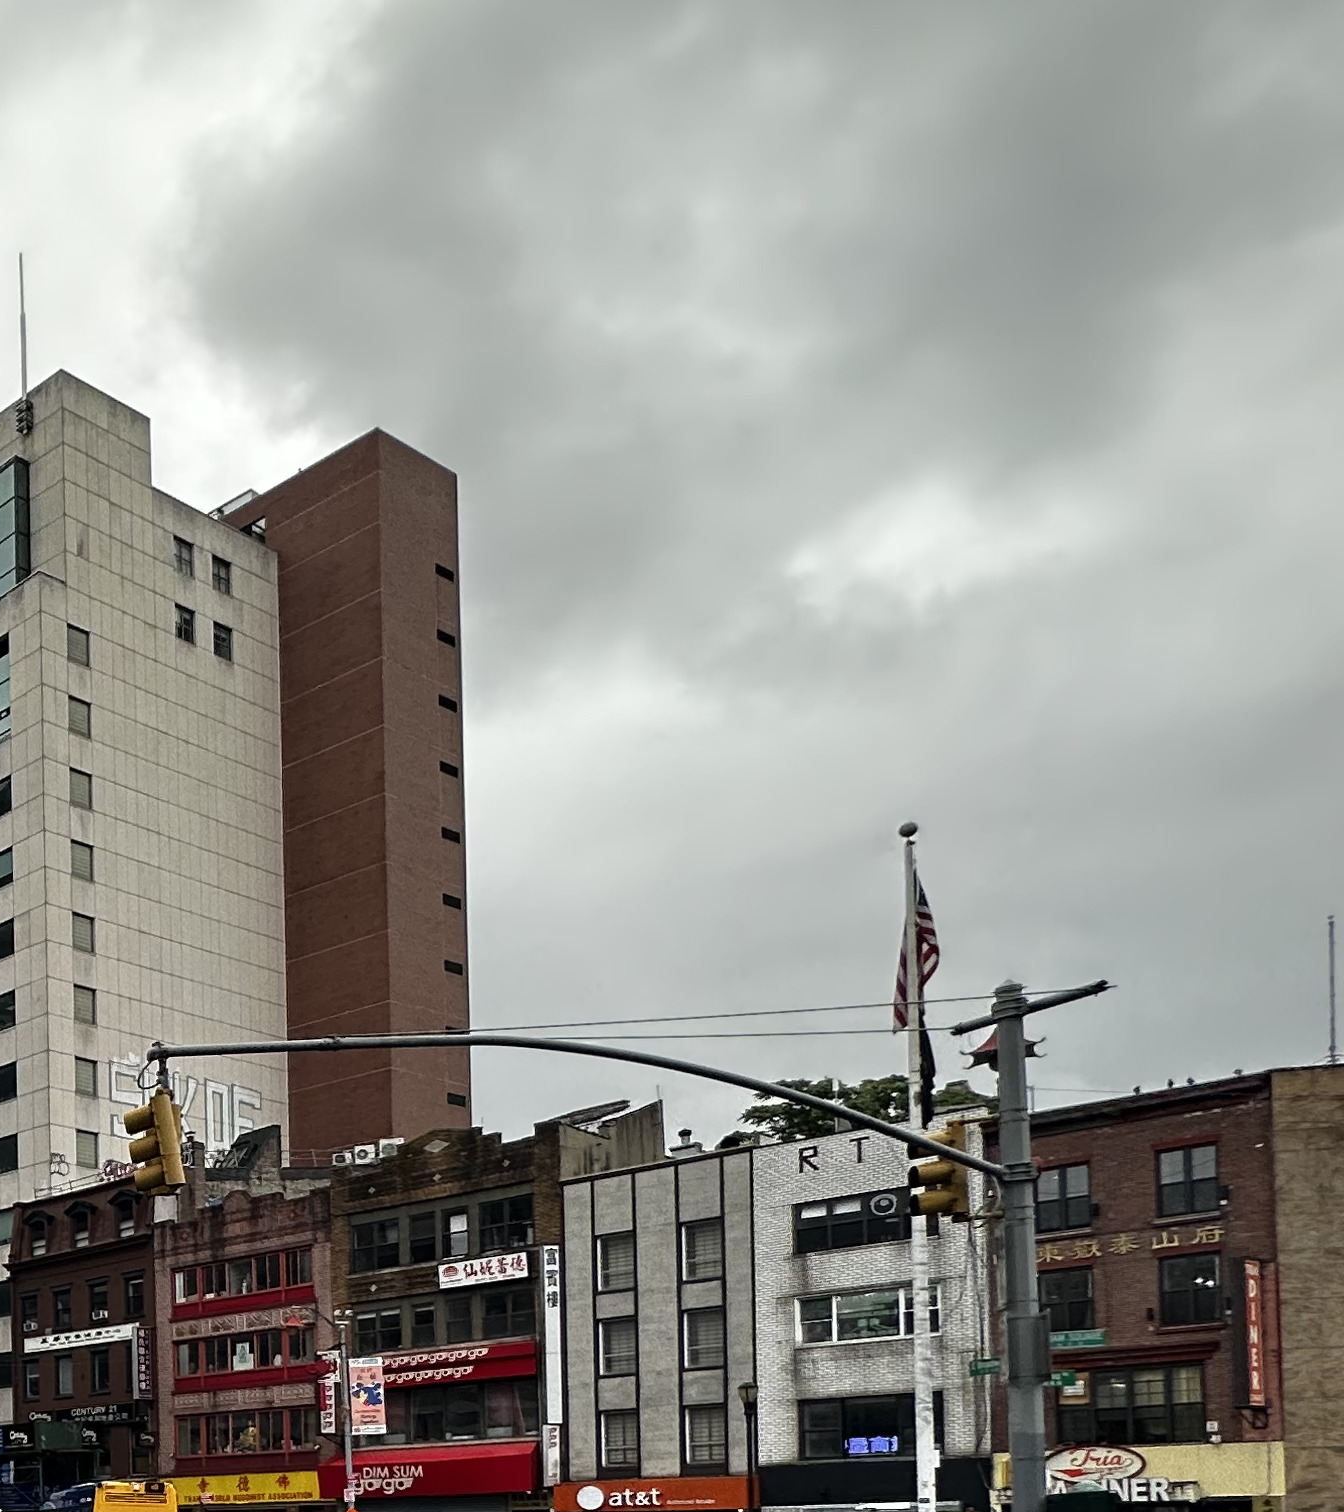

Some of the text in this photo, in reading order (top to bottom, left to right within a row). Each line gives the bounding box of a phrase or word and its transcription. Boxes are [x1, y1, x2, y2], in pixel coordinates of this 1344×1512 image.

[1248, 1278, 1261, 1390] DINER
[363, 1465, 423, 1478] DIM SUM
[608, 1487, 661, 1506] at&t
